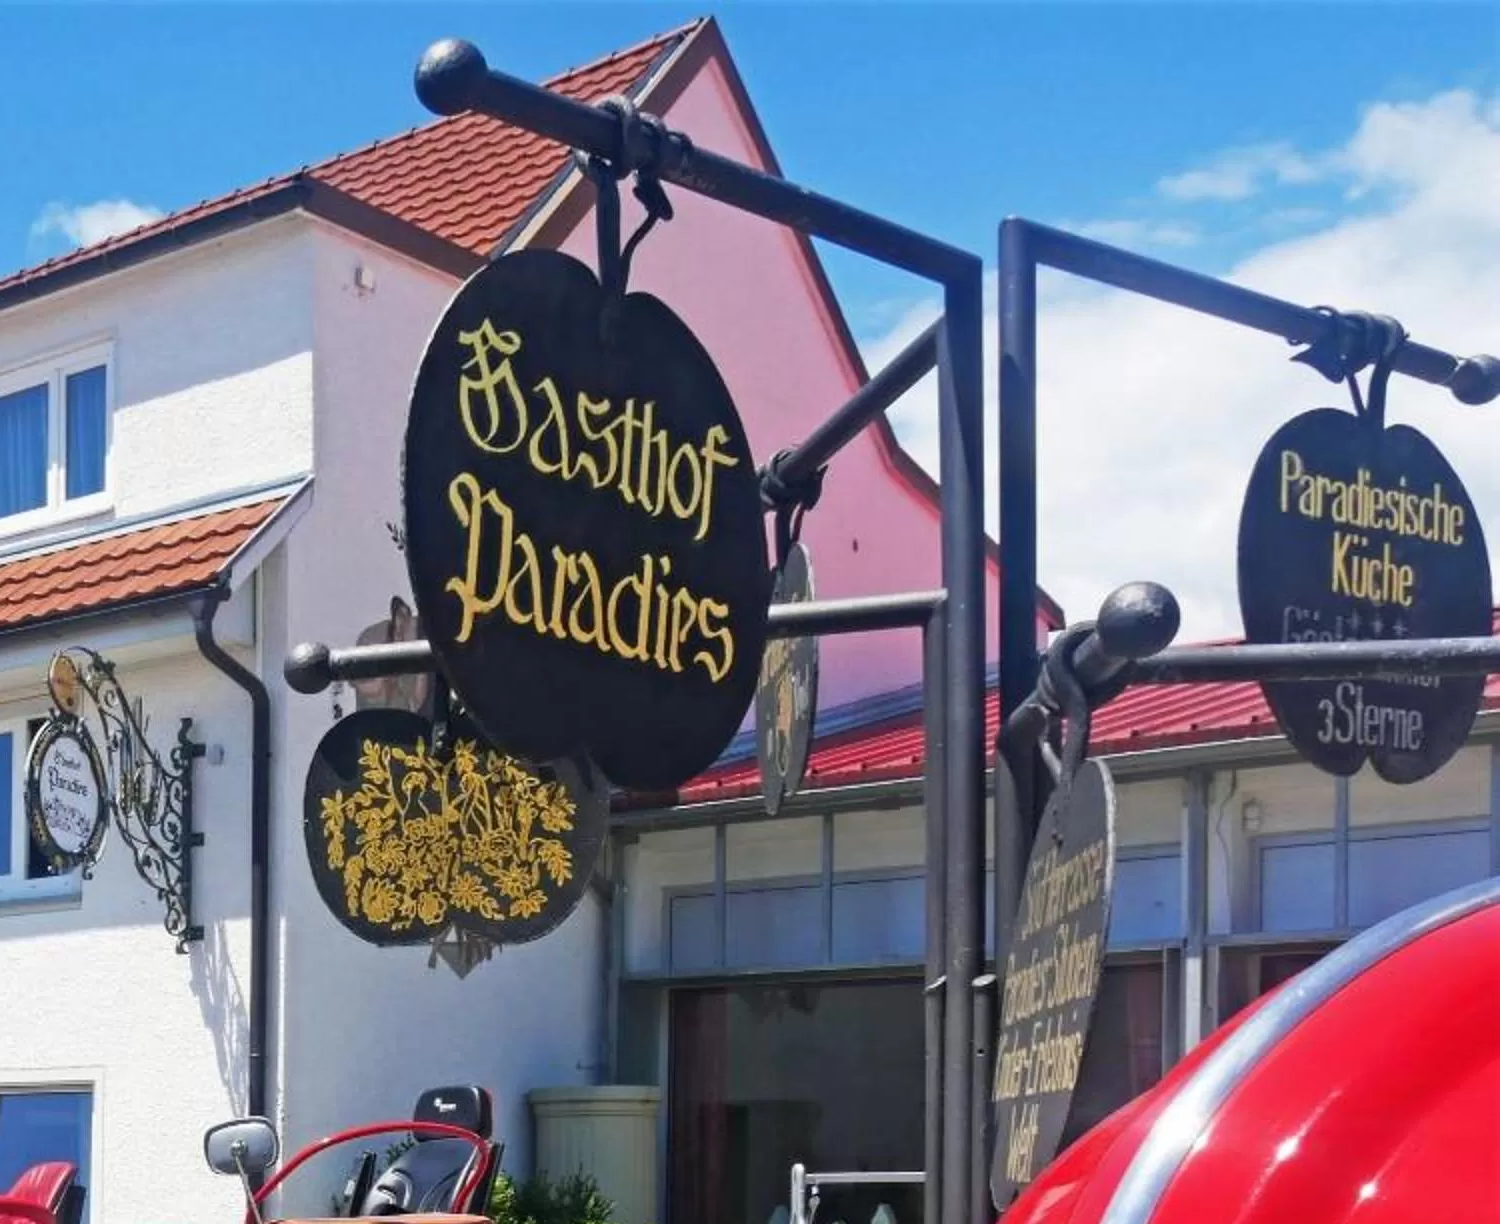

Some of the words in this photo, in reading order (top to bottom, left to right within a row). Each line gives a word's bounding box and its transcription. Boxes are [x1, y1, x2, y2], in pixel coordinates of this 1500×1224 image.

[457, 318, 739, 541] Gasthof
[1280, 450, 1465, 546] Paradiesische
[446, 472, 736, 683] Paradies
[1331, 531, 1414, 608] Küche
